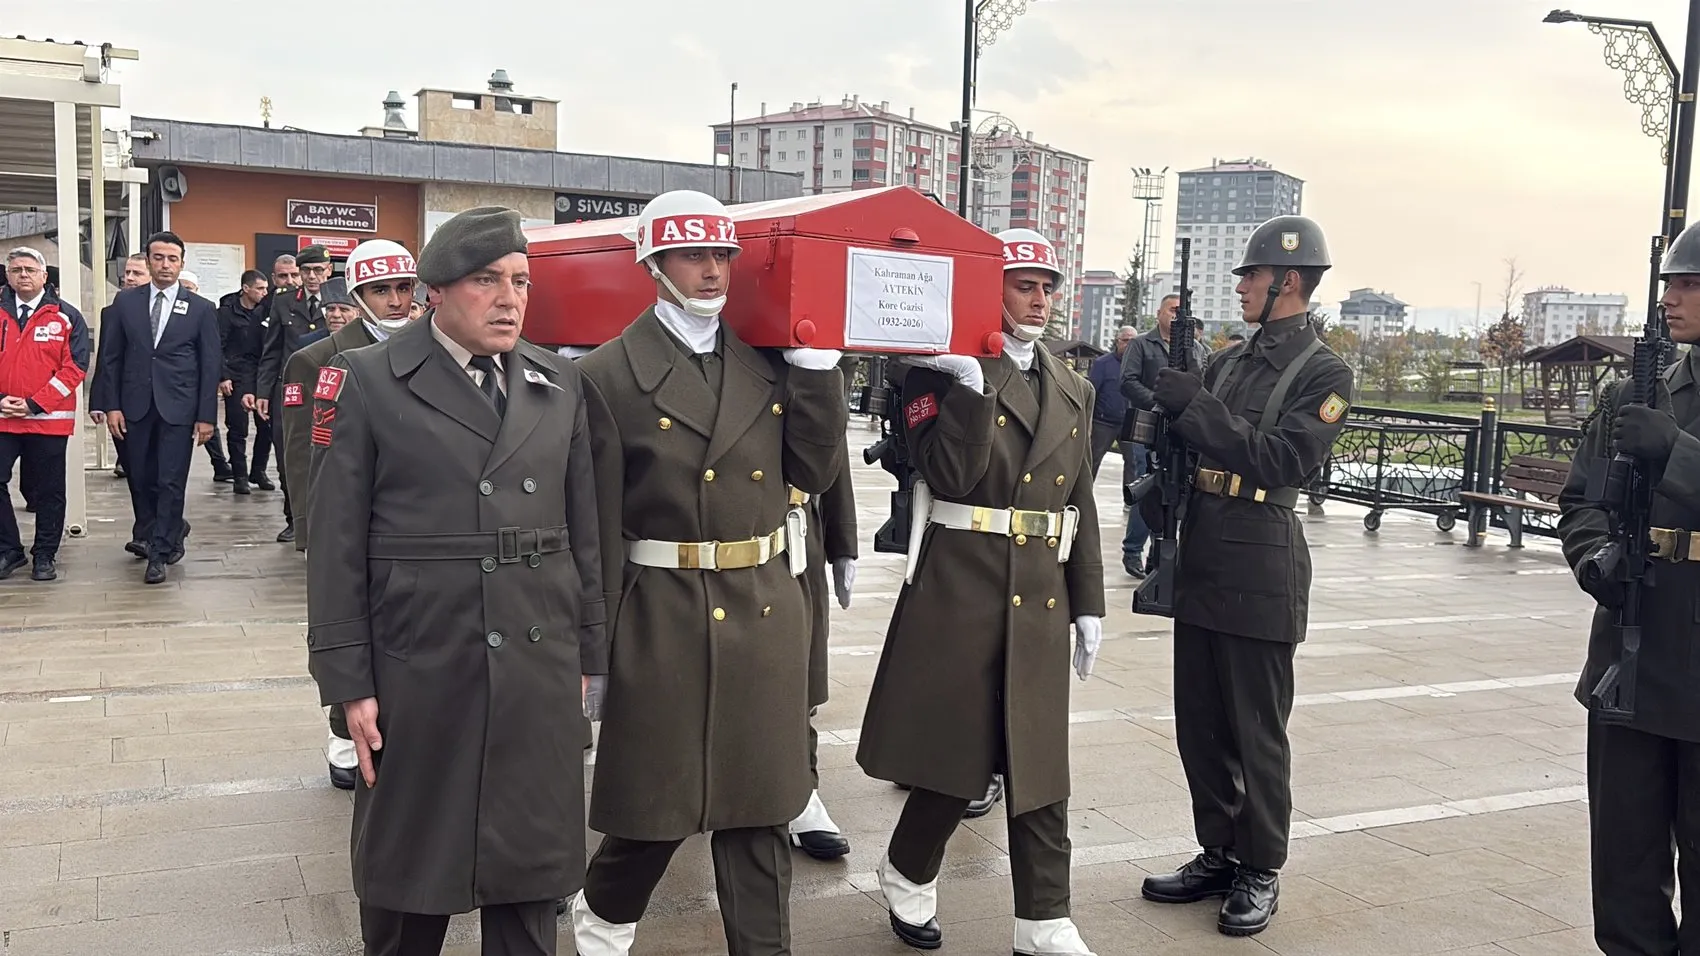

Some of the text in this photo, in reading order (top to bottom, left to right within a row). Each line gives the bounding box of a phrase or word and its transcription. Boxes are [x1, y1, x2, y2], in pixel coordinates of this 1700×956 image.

[309, 205, 357, 217] BAY WC
[294, 214, 369, 228] Abdesthane
[874, 267, 933, 283] Kahraman Ağa
[882, 284, 924, 296] AYTEKİN
[878, 300, 924, 312] Kore Gazisi
[877, 316, 924, 329] (1932-2026)
